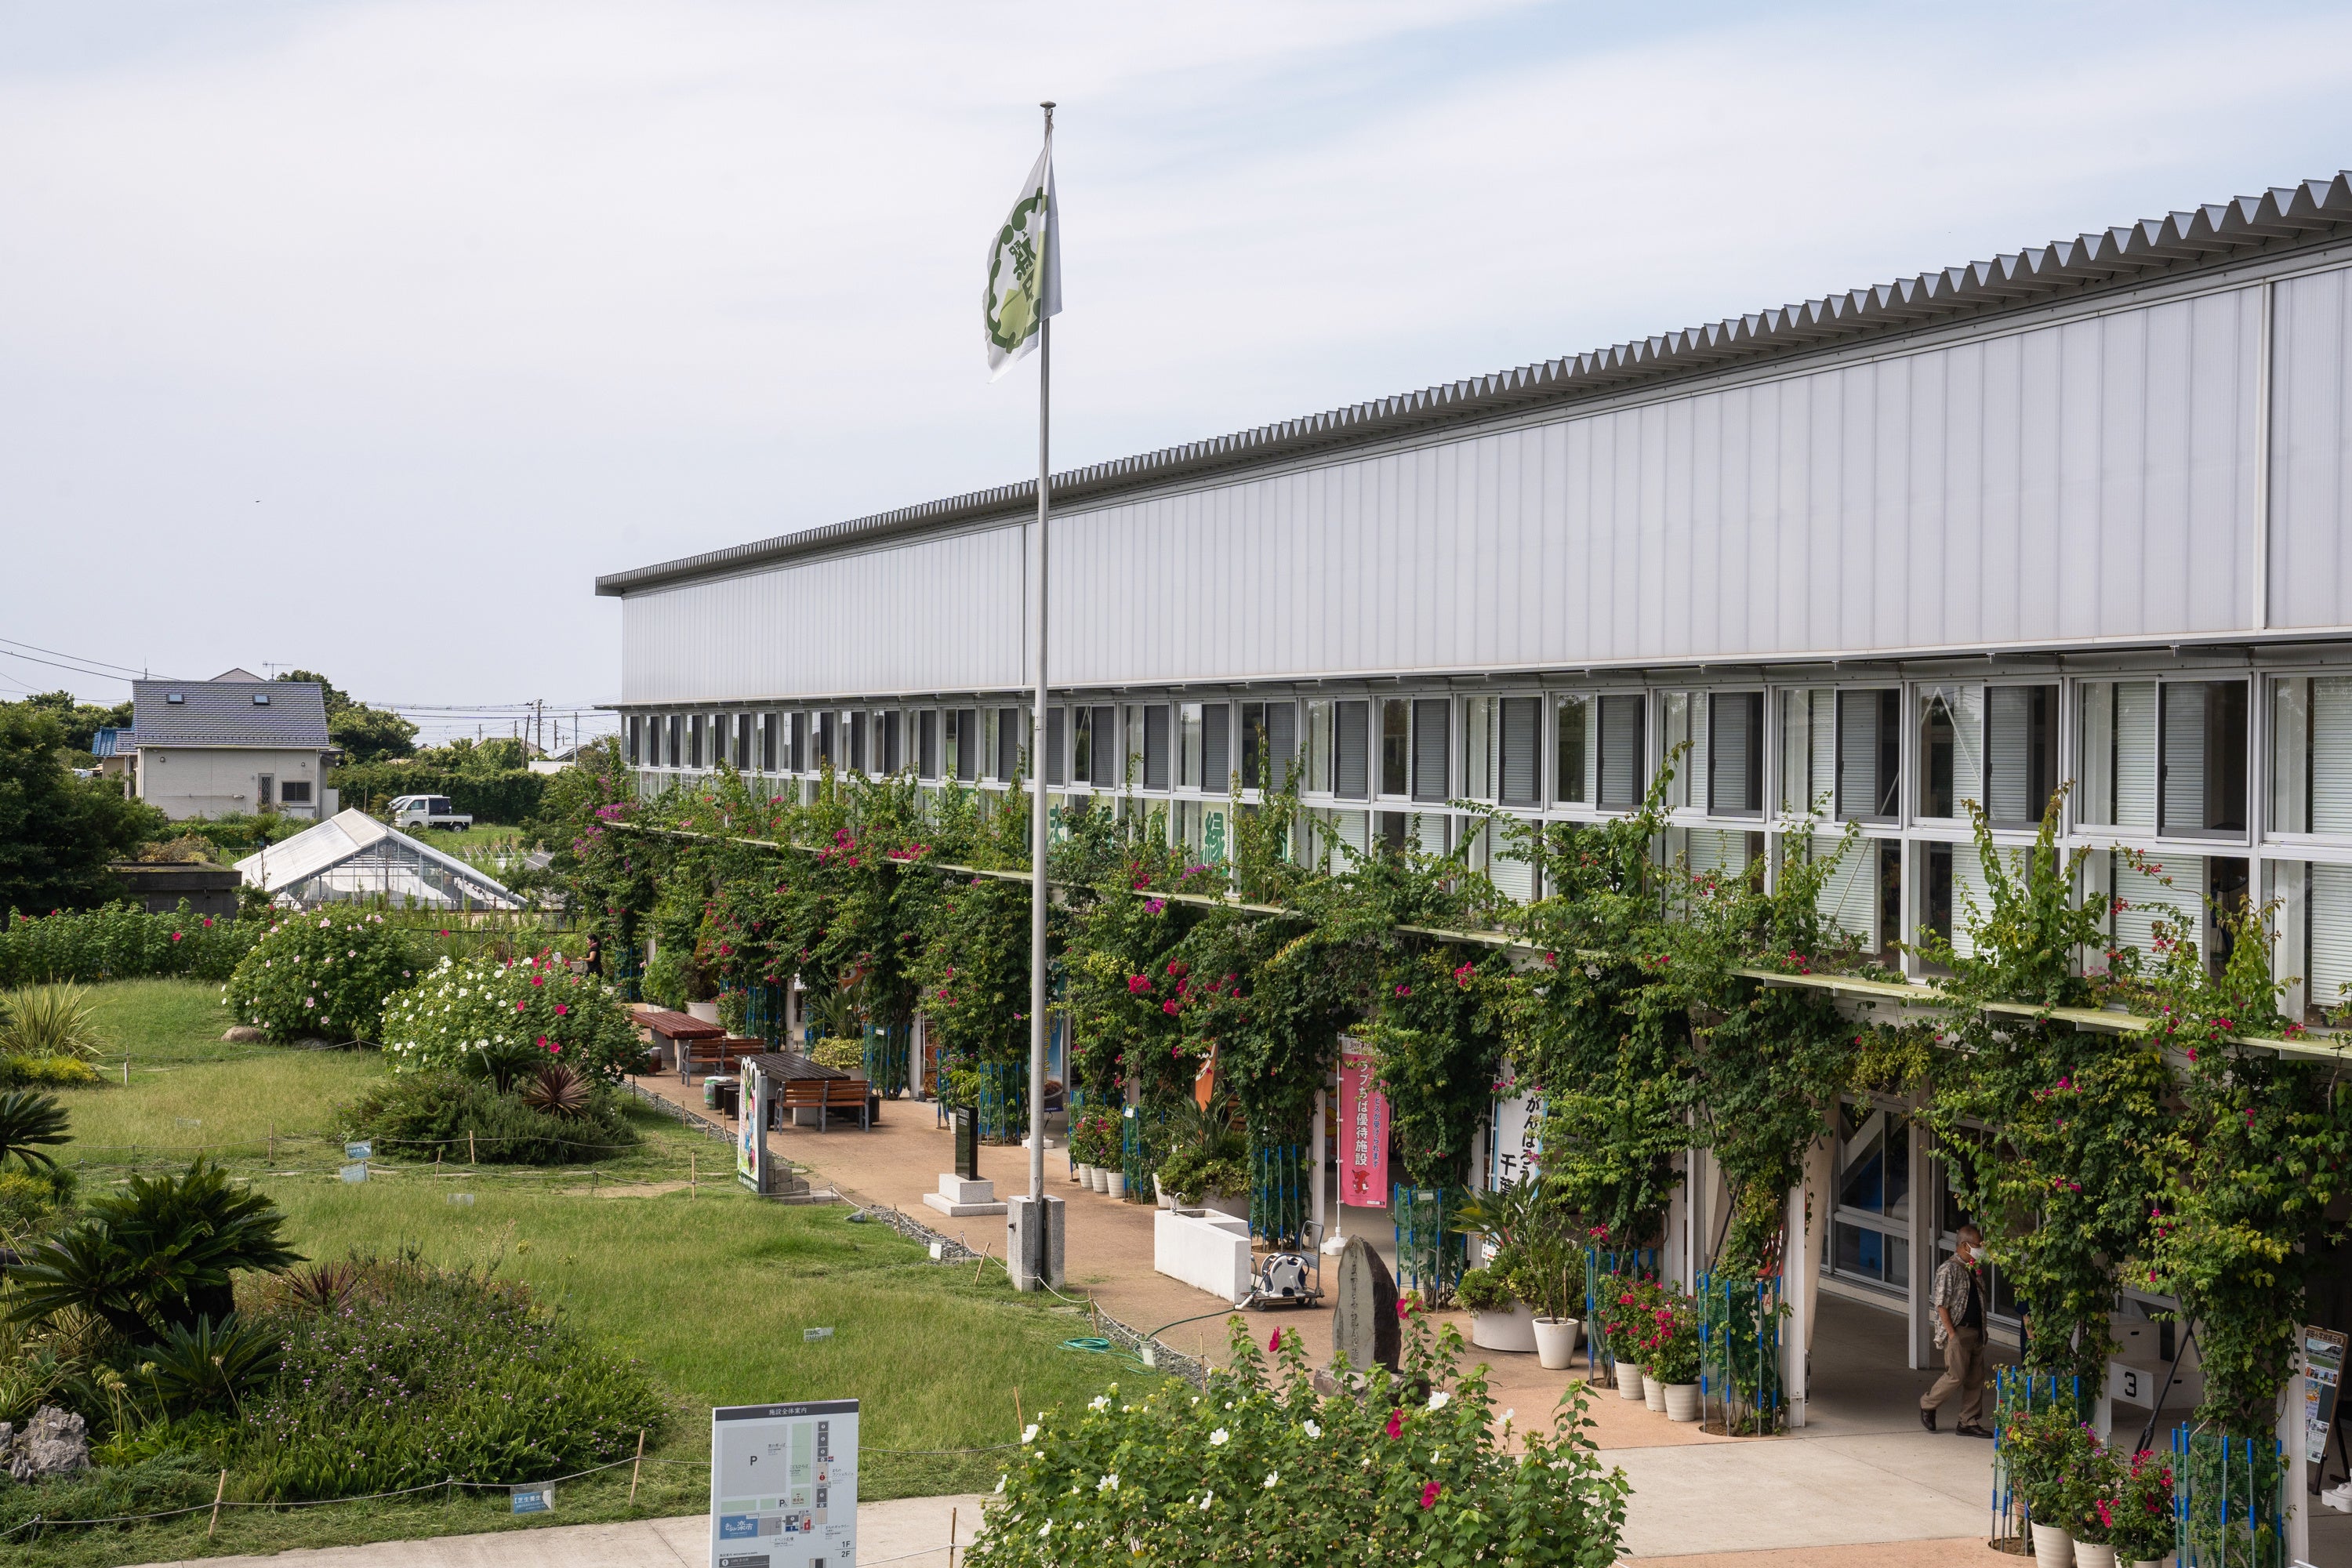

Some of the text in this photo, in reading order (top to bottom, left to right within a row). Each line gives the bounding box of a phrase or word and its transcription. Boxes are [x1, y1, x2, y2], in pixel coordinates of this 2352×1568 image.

[2125, 1371, 2136, 1398] 3
[769, 1406, 808, 1416] 施設全体案内
[750, 1456, 758, 1466] P
[779, 1499, 786, 1508] P
